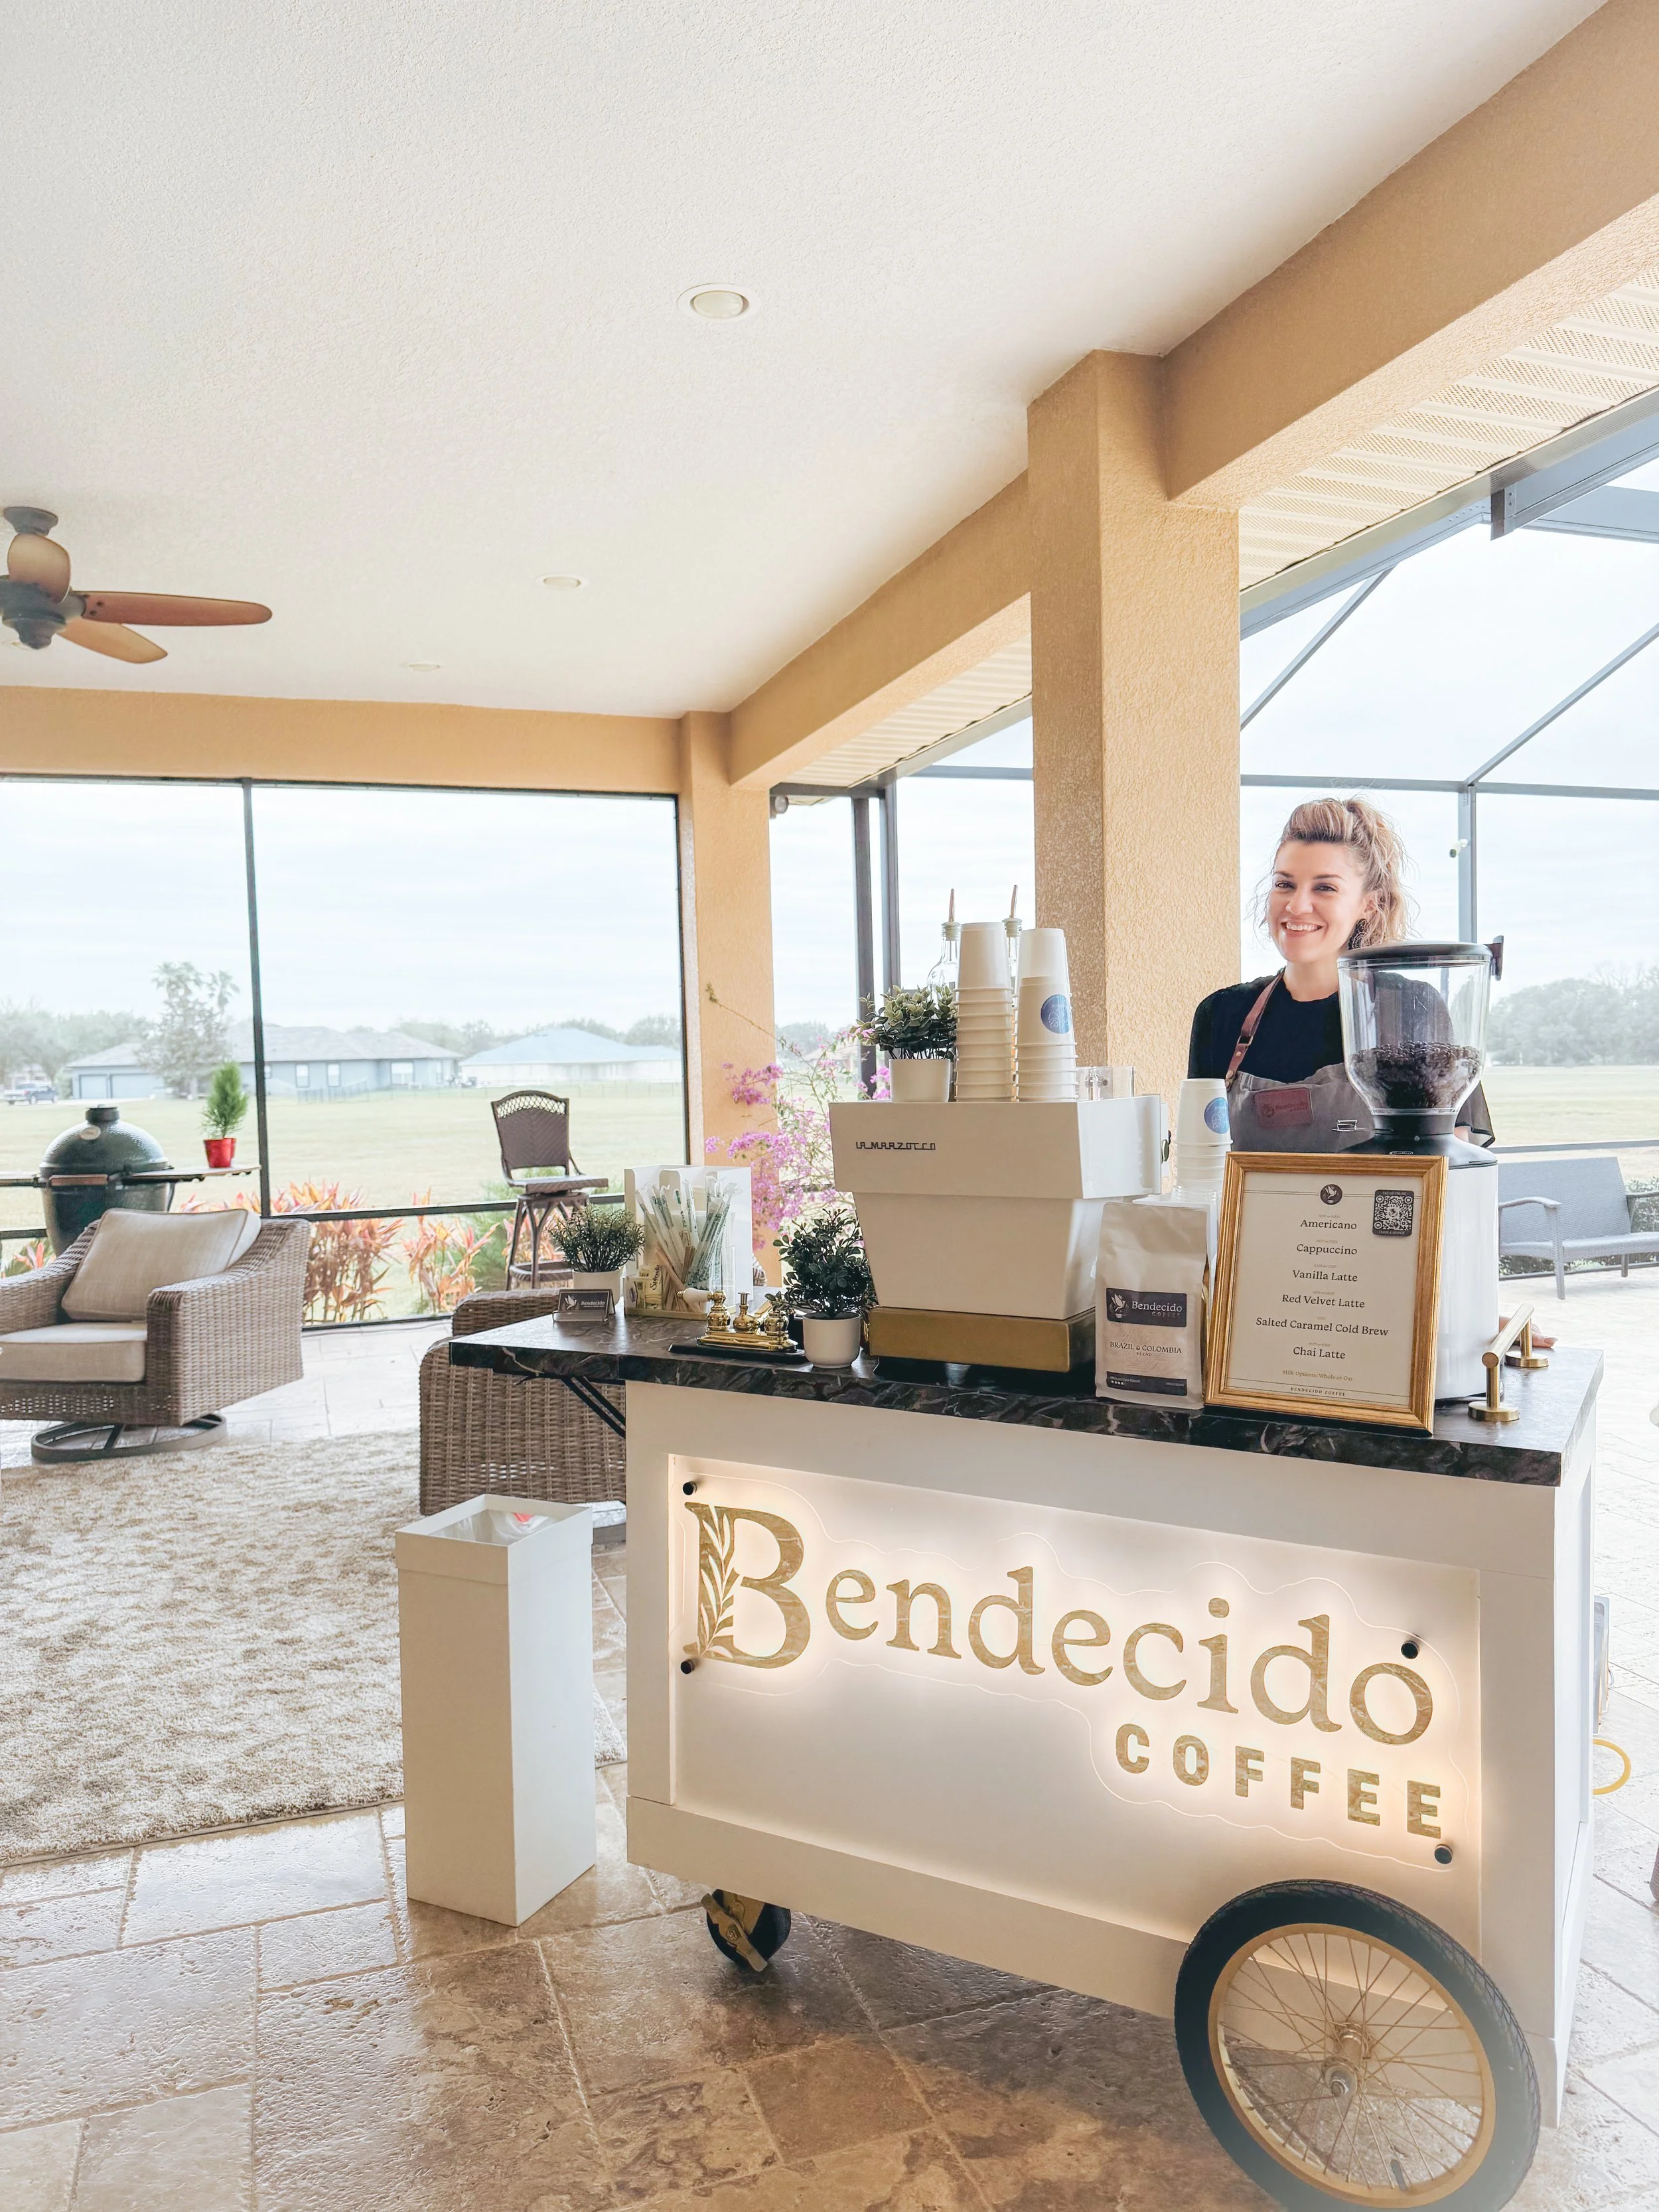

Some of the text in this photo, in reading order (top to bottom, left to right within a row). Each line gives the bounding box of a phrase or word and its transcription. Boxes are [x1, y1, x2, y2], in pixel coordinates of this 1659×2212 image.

[871, 1142, 936, 1151] MARZOCCO
[1299, 1219, 1358, 1230] Americano
[1296, 1244, 1358, 1255] Cappuccino
[650, 1264, 662, 1291] Splenda
[1292, 1270, 1358, 1282] Vanilla Latte
[1131, 1301, 1183, 1312] Bendecido
[1281, 1294, 1365, 1308] Red Velvet Latte
[1256, 1317, 1390, 1336] Salted Caramel Cold Brew
[1110, 1341, 1134, 1351] BRAZIL
[1141, 1345, 1183, 1354] COLOMBIA
[1293, 1347, 1346, 1359] Chai Latte
[684, 1501, 1433, 1745] Bendecido
[1116, 1724, 1442, 1839] COFFEE
